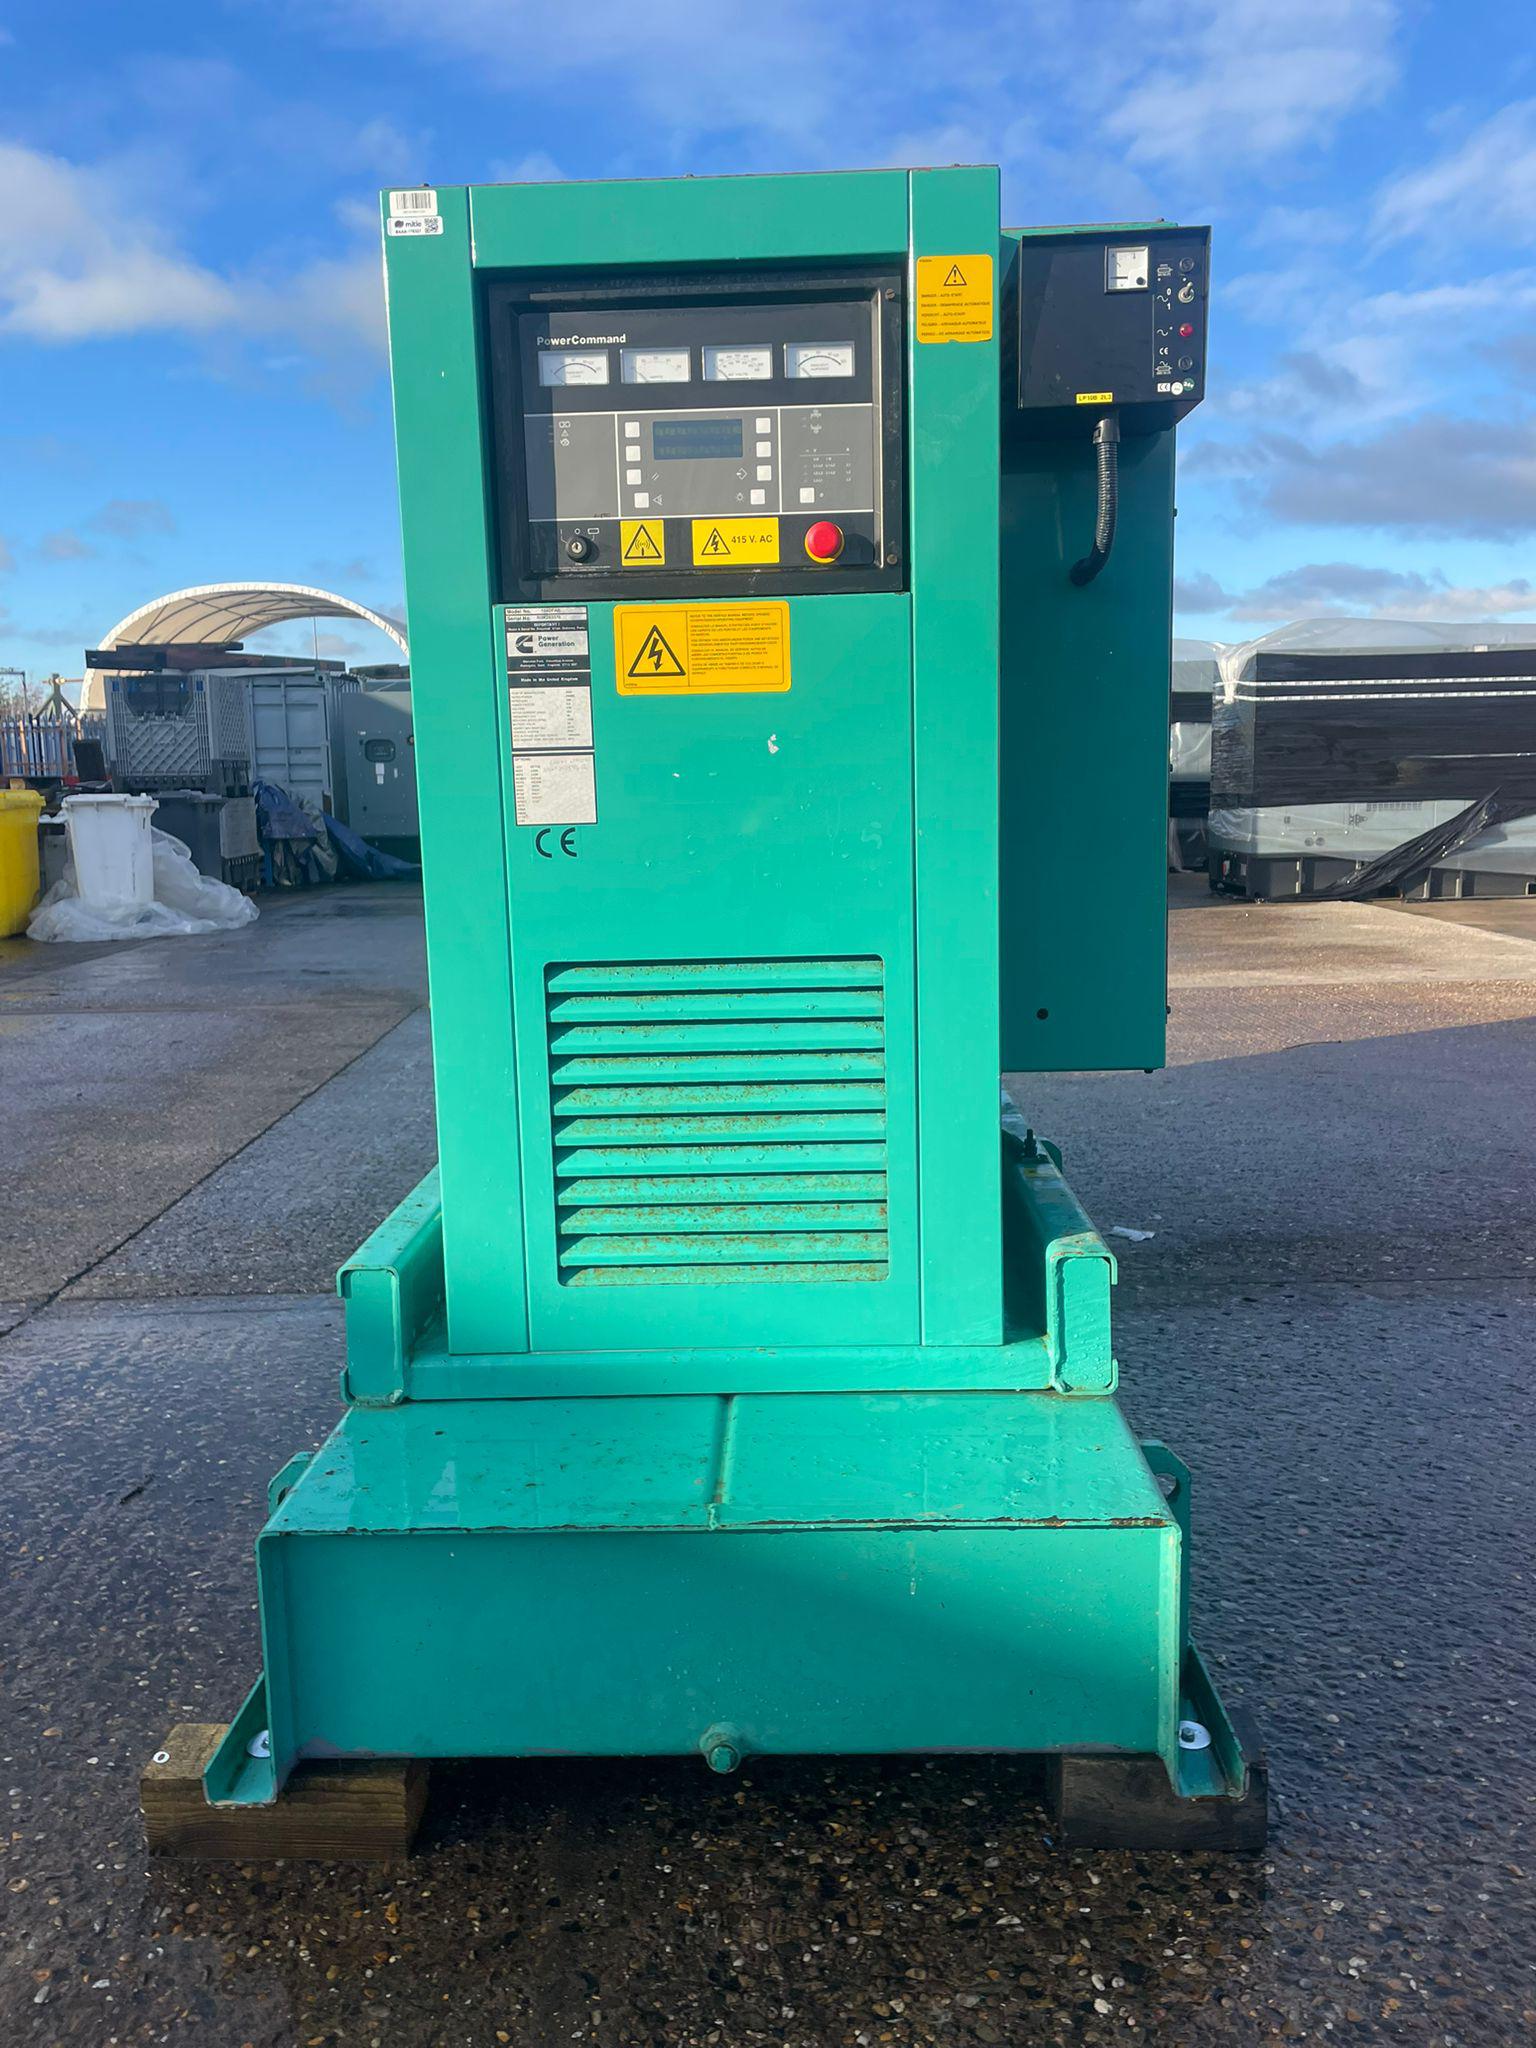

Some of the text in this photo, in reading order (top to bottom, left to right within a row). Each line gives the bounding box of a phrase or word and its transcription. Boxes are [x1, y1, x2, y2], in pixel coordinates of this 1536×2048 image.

[537, 333, 627, 346] PowerCommand
[731, 535, 747, 544] 415
[759, 534, 773, 543] AC
[535, 827, 578, 859] CE
